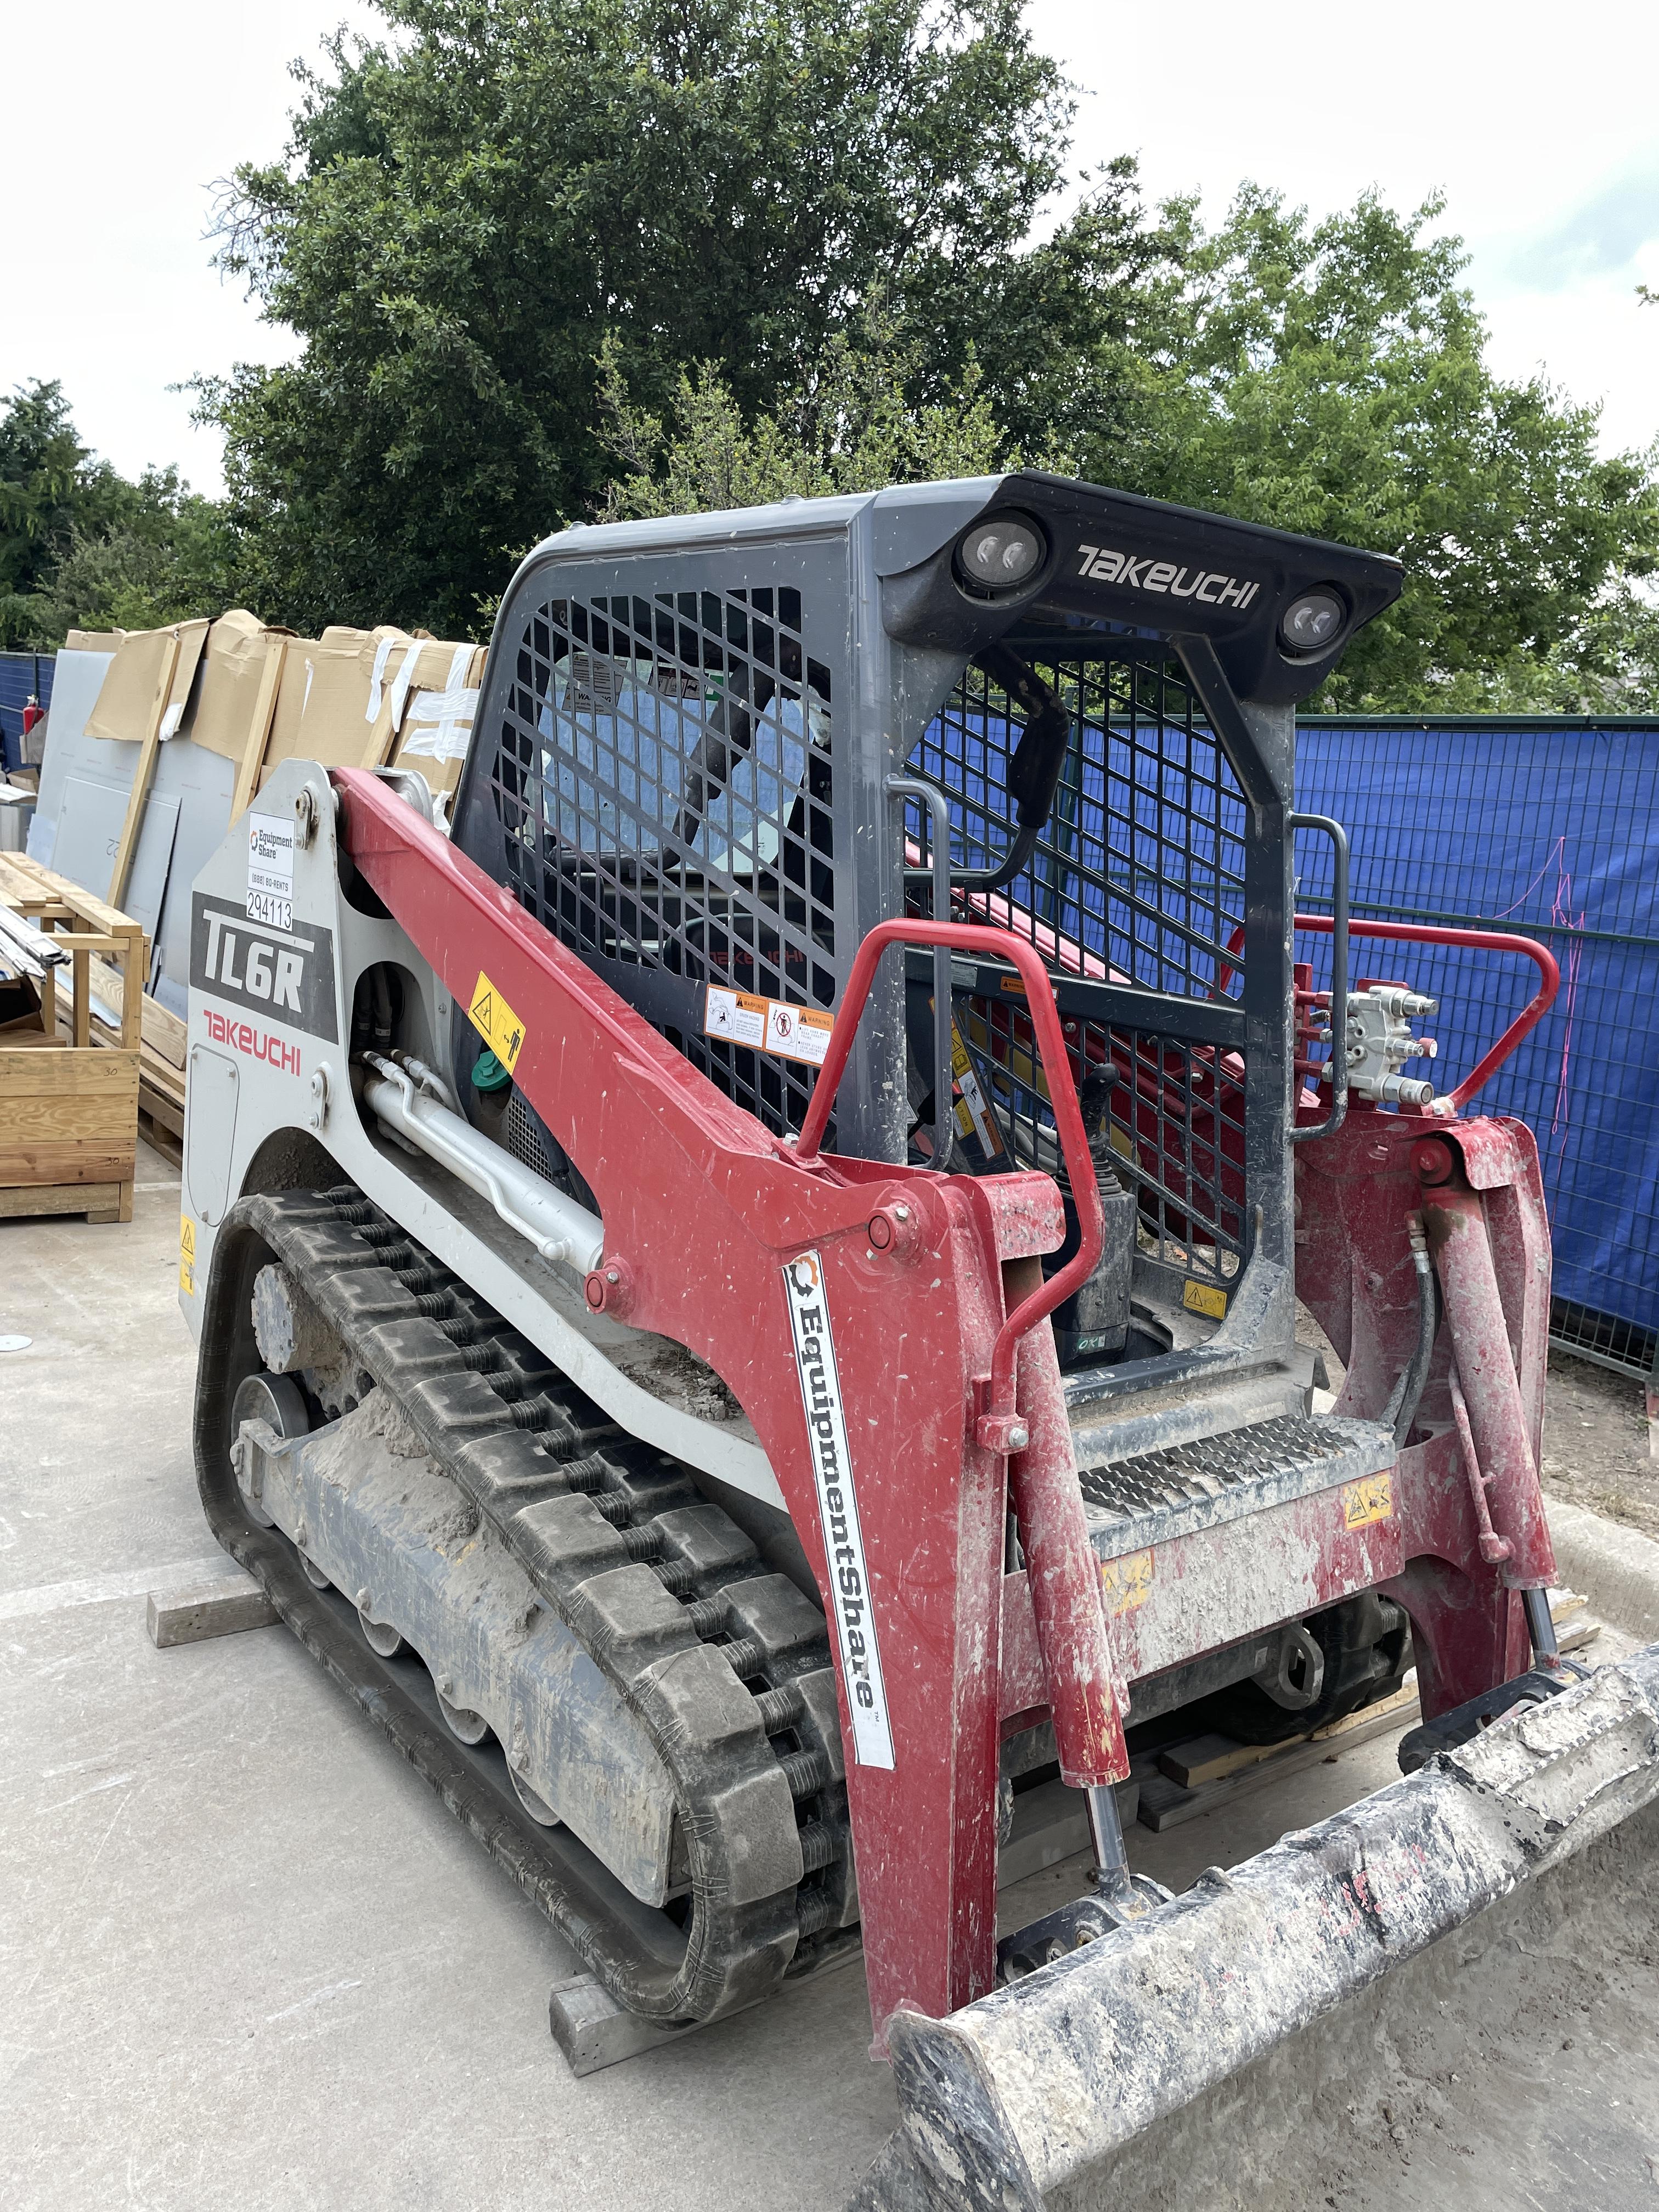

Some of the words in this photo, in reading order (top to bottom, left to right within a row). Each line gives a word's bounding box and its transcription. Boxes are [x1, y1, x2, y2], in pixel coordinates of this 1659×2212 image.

[1078, 544, 1260, 609] TAKEUCHI
[259, 830, 292, 848] Equipment
[258, 845, 276, 859] Share
[252, 873, 264, 885] (888)
[247, 892, 291, 929] 294113
[203, 909, 315, 1013] TL6R
[744, 1001, 763, 1009] WARNING
[809, 1017, 830, 1026] WARNING
[204, 1009, 301, 1077] TAKEUCHI
[103, 1068, 117, 1076] 30
[799, 1305, 874, 1708] EquipmentShare
